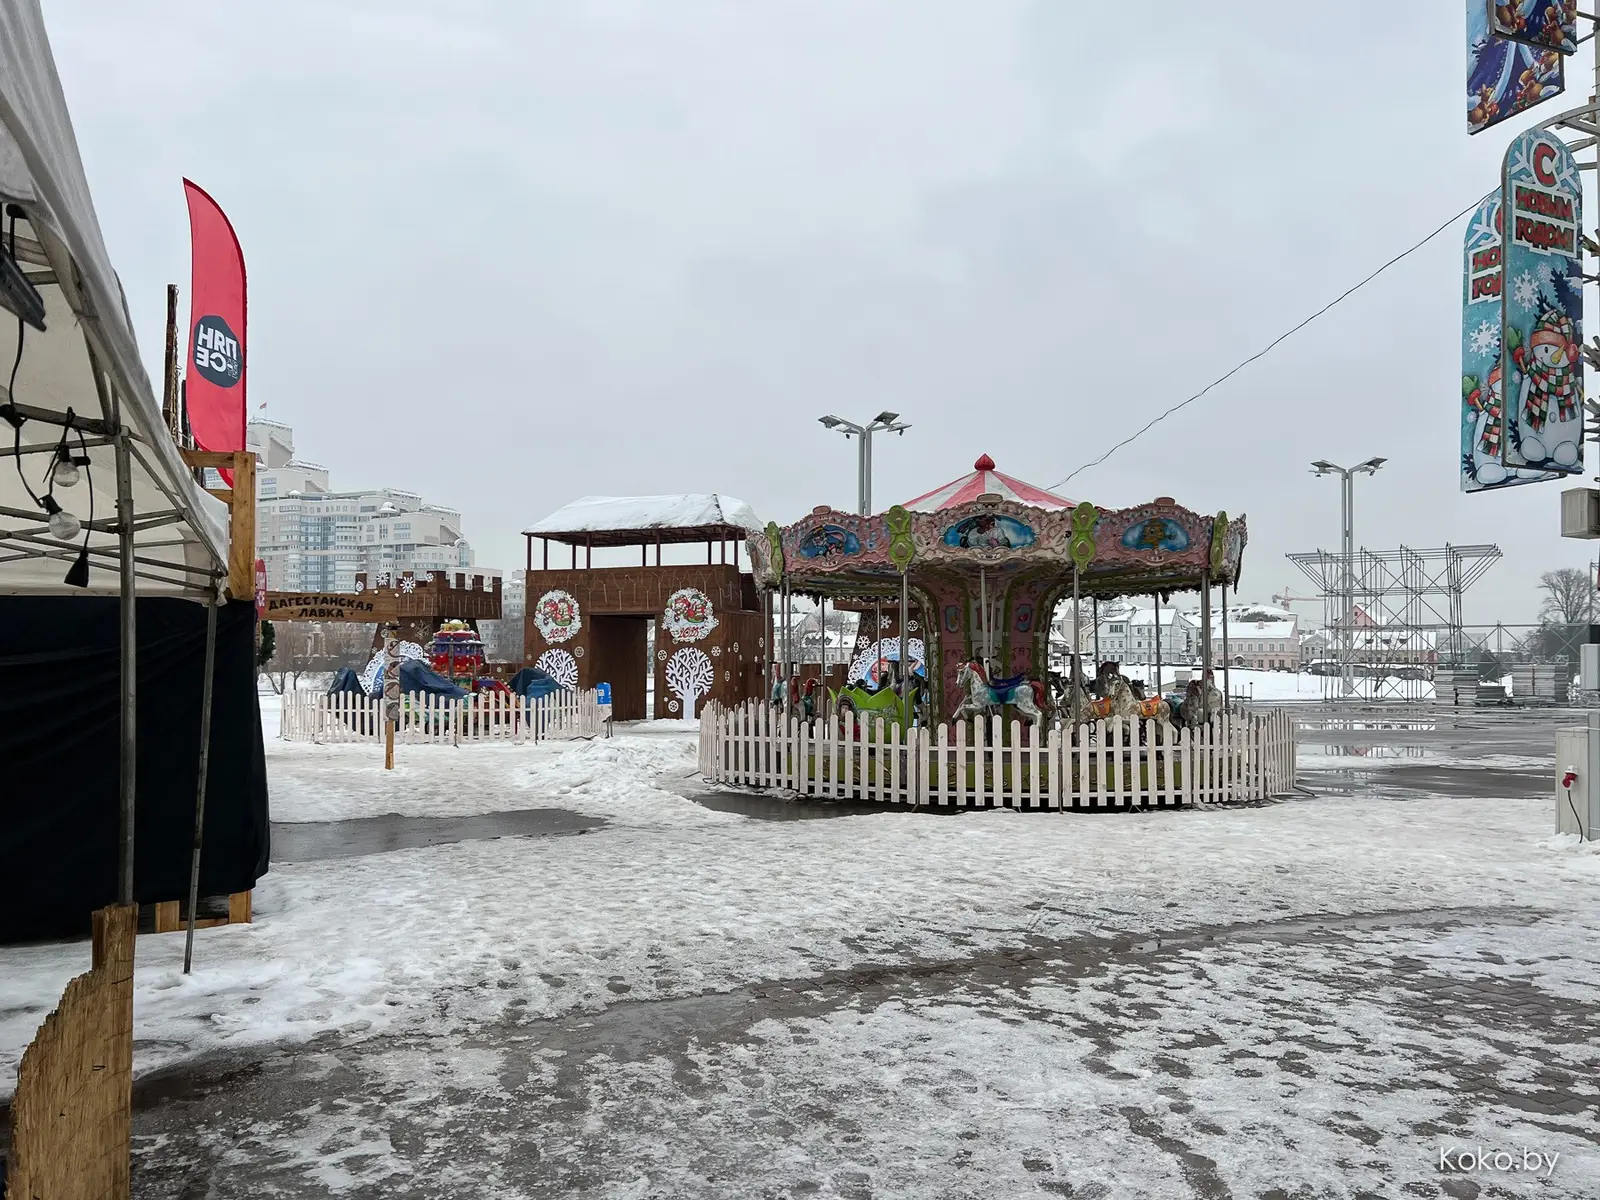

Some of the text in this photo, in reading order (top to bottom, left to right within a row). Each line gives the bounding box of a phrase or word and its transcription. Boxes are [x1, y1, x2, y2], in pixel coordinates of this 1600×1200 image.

[1533, 142, 1557, 186] С
[1516, 186, 1573, 219] НОВЫМ
[1473, 246, 1502, 271] НО
[268, 596, 374, 612] ДАГЕСТАНСКАЯ
[298, 608, 345, 618] ЛАВКА
